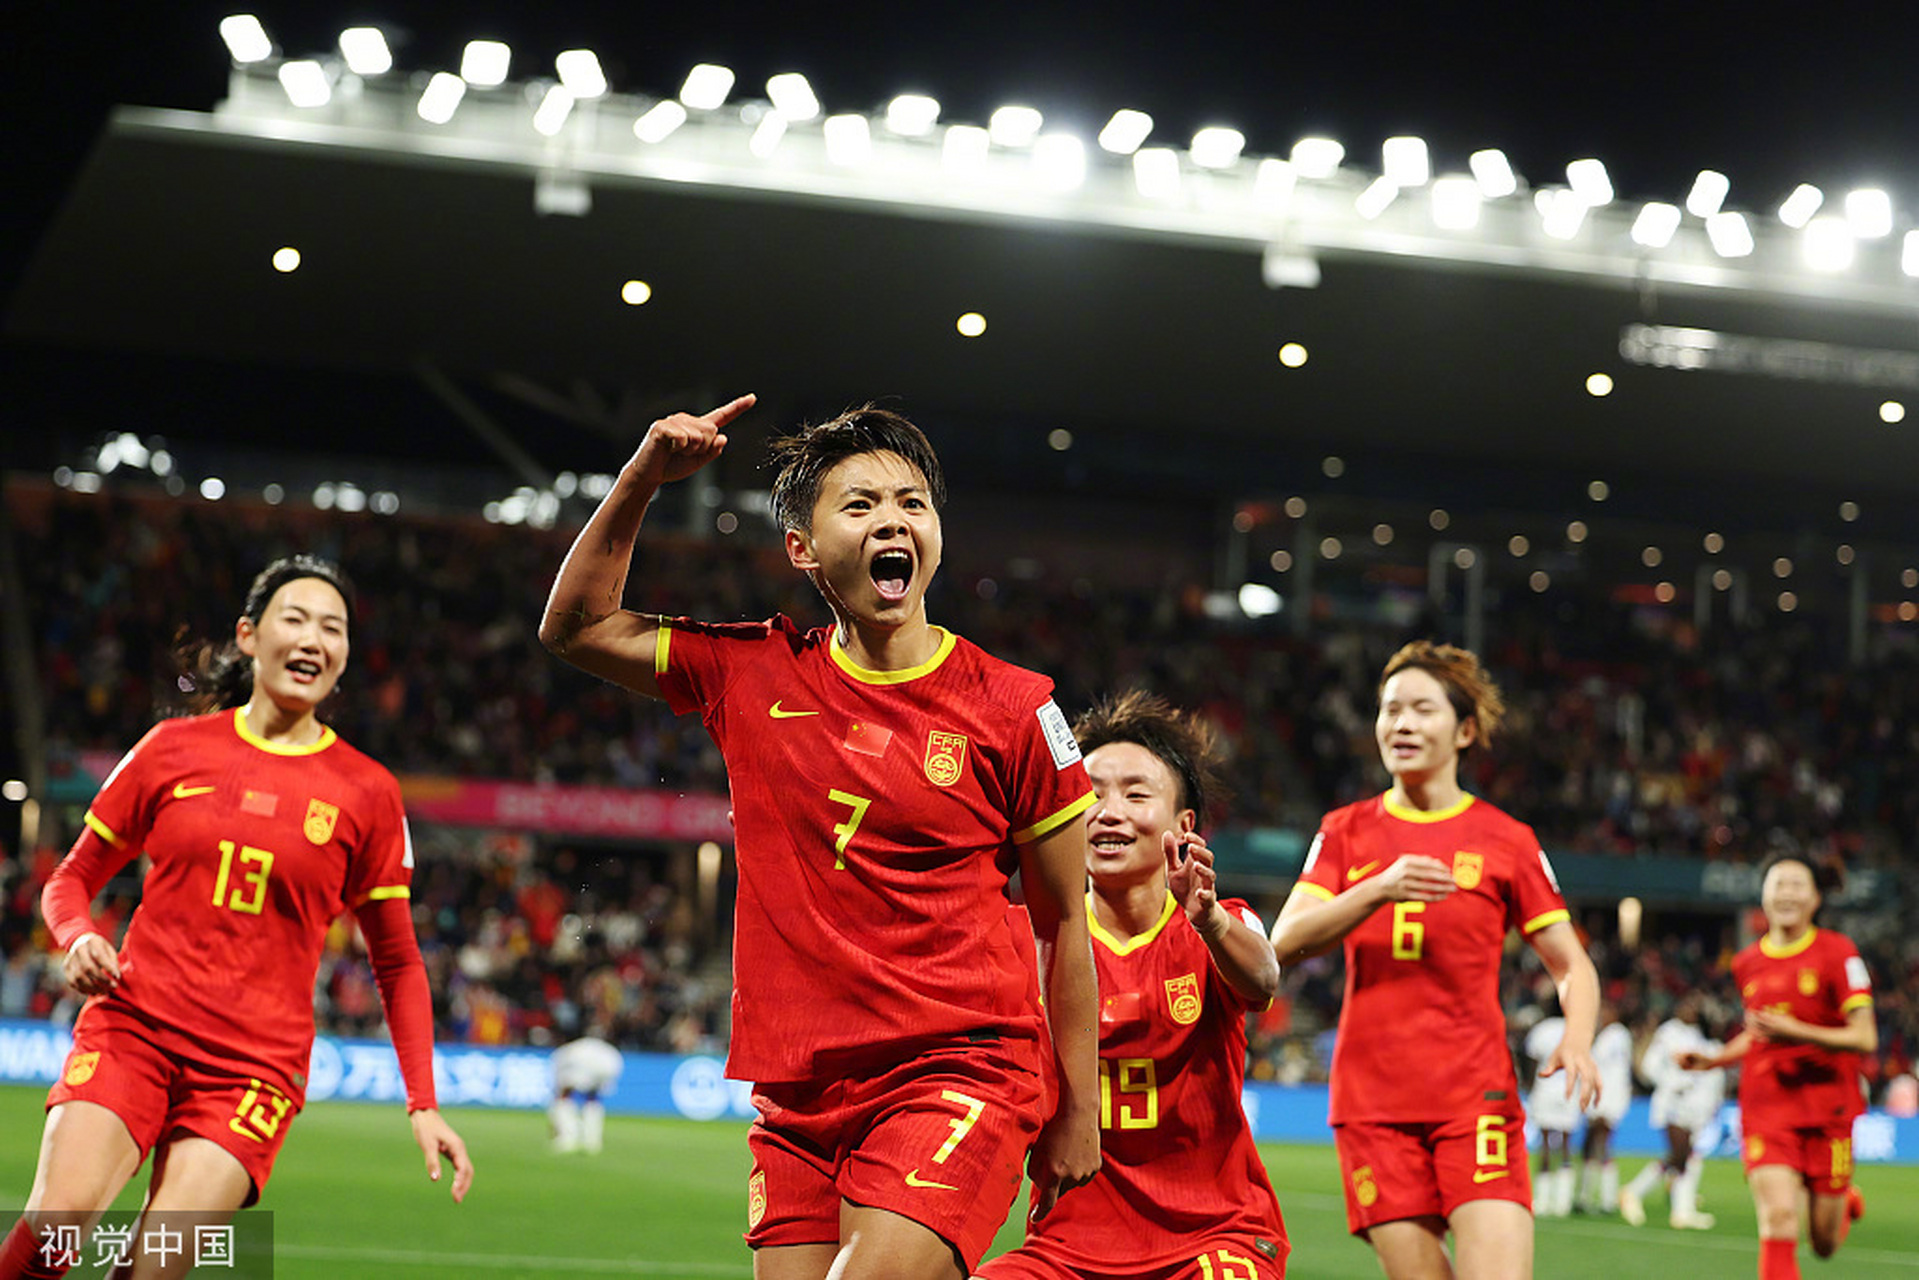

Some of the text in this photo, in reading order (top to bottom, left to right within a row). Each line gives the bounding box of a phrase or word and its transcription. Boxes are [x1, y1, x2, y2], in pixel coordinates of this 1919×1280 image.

[828, 789, 871, 870] 7
[212, 840, 274, 914] 13
[1392, 901, 1426, 960] 6
[932, 1090, 986, 1164] 7
[1099, 1058, 1158, 1129] 19
[1476, 1115, 1508, 1166] 6
